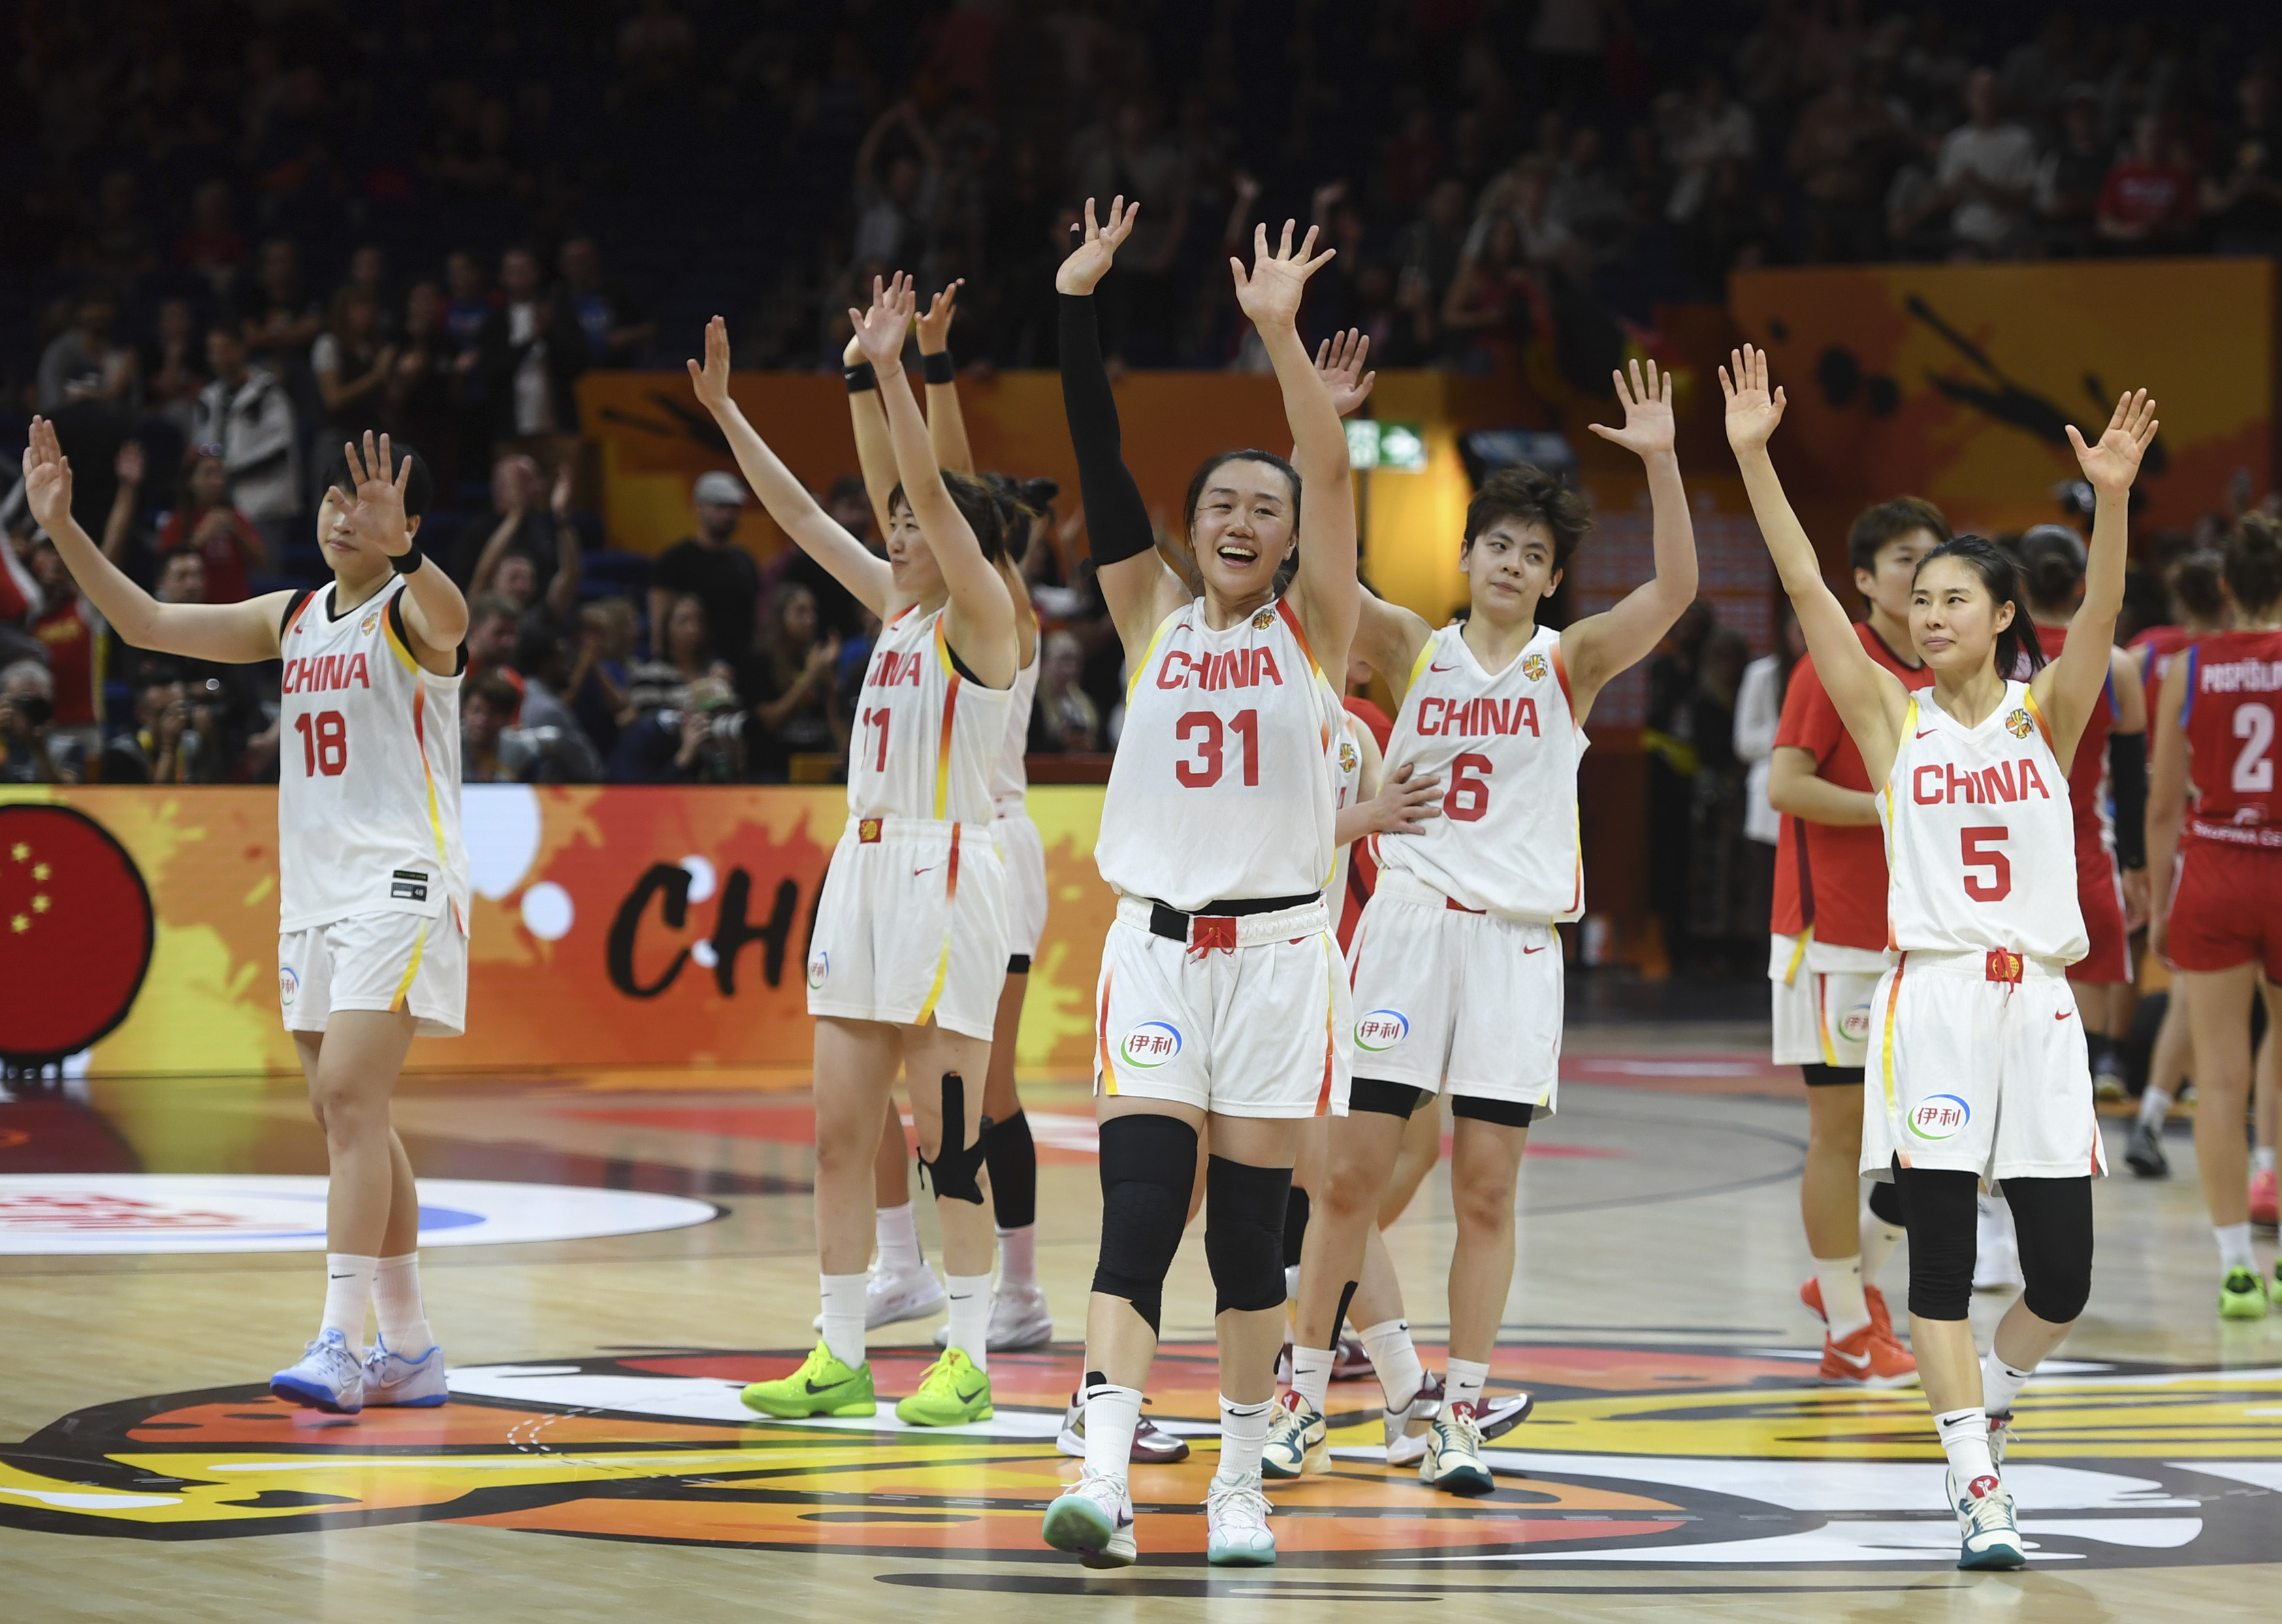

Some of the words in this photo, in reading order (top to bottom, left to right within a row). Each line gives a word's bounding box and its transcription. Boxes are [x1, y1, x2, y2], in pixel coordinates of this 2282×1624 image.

[282, 652, 370, 694] CHINA
[1156, 646, 1283, 691] CHINA
[1416, 697, 1540, 737] CHINA
[294, 710, 348, 777] 18
[1176, 709, 1259, 788] 31
[2232, 702, 2274, 792] 2
[1443, 753, 1493, 822] 6
[1912, 758, 2050, 805] CHINA
[1961, 826, 2010, 902] 5
[606, 860, 825, 999] CH
[1128, 1035, 1173, 1056] 伊利
[1360, 1021, 1400, 1039] 伊利
[1917, 1107, 1961, 1127] 伊利
